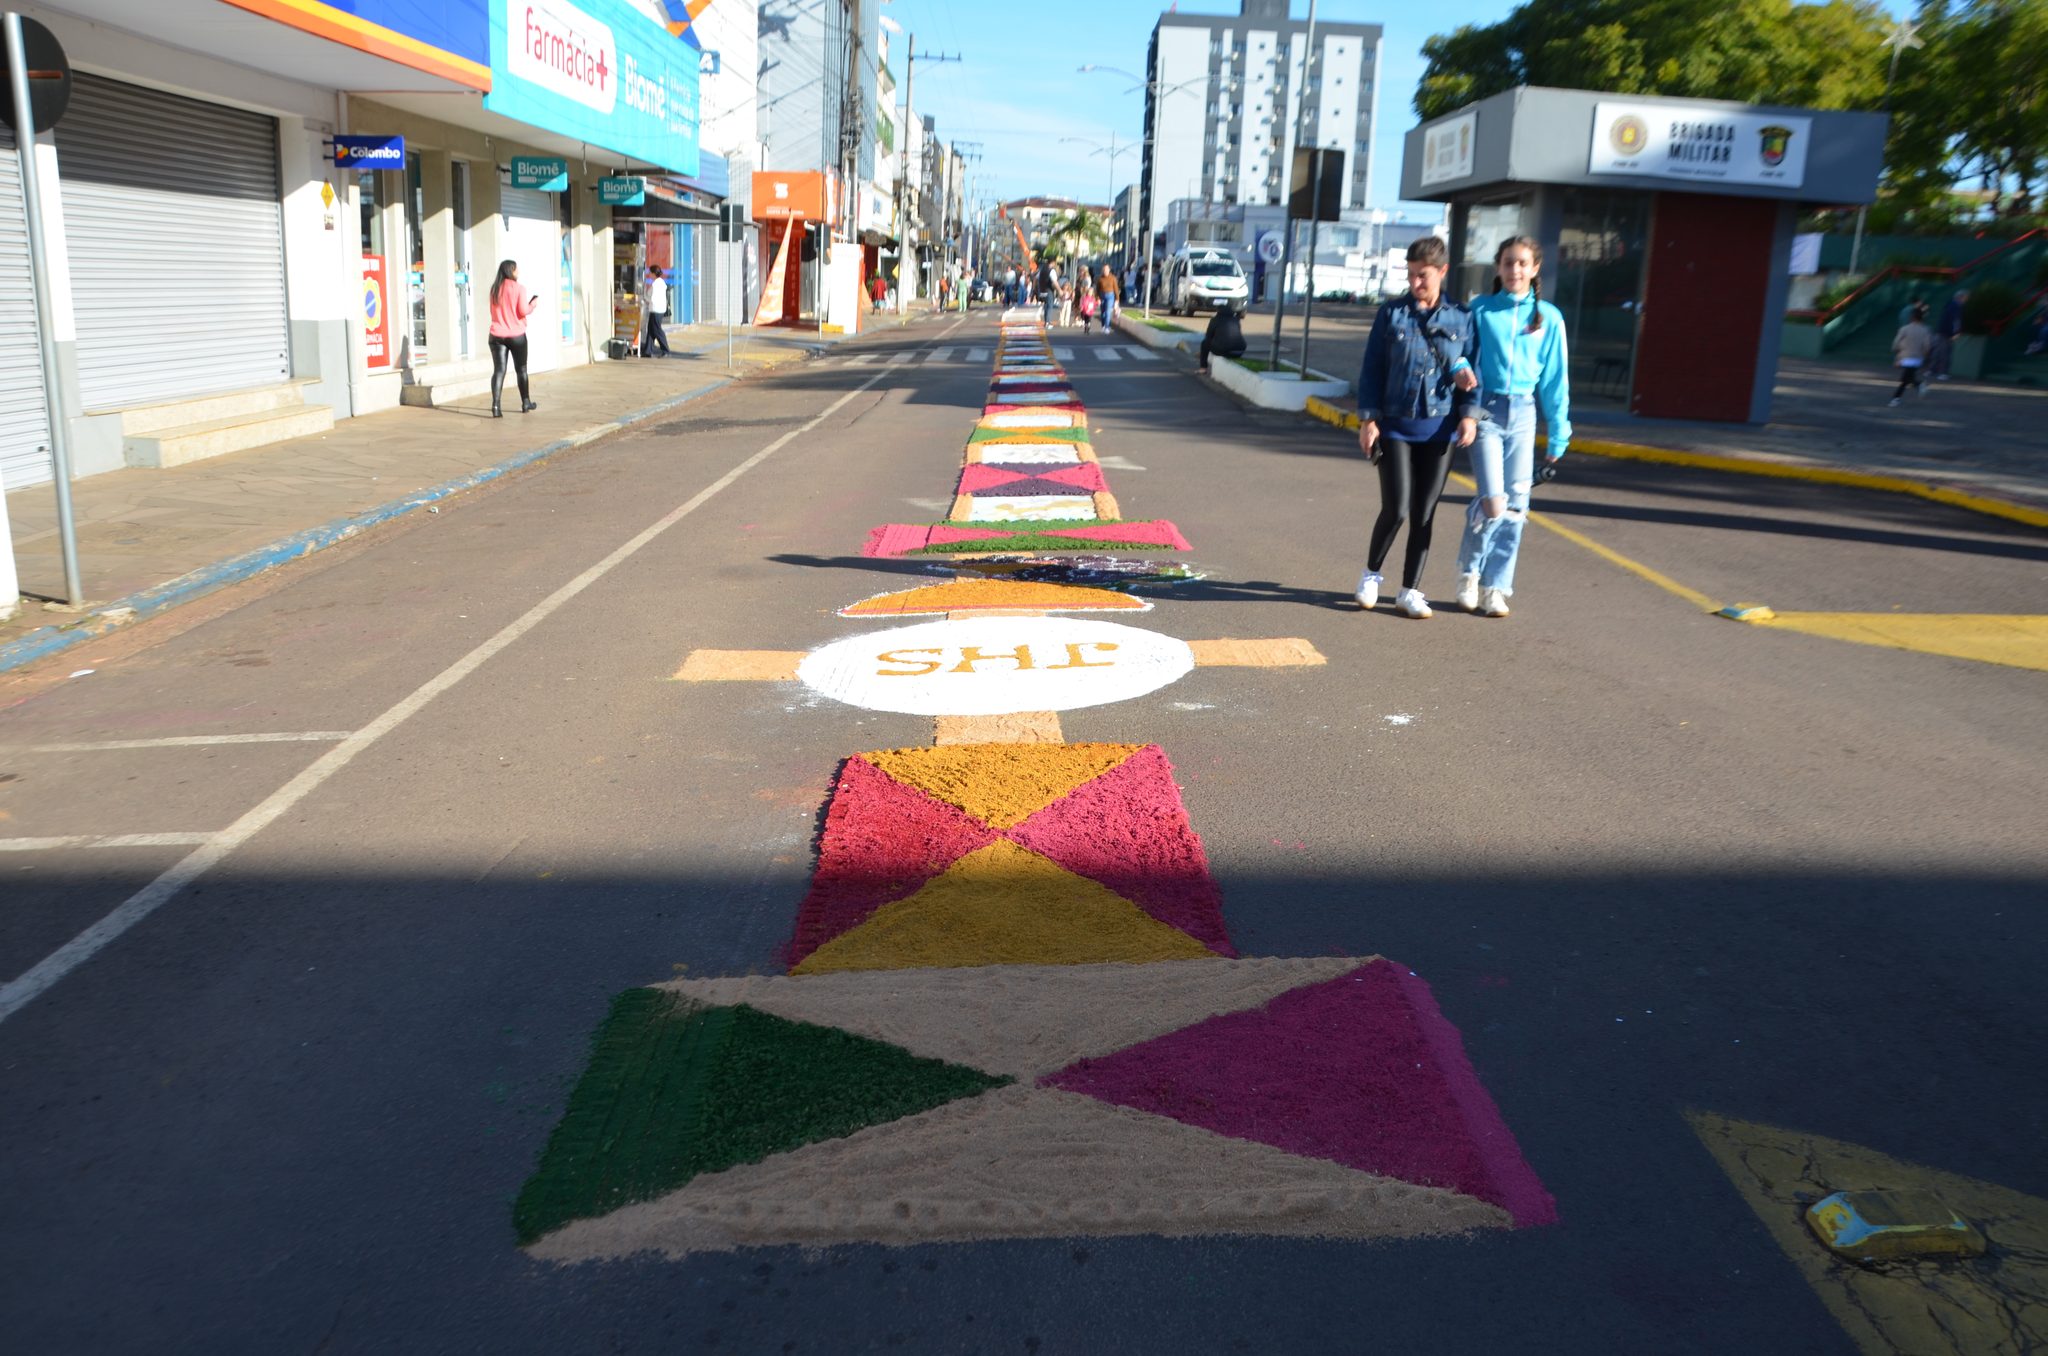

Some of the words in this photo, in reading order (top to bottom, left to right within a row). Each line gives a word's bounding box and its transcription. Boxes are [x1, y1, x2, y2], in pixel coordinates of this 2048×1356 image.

[1669, 121, 1736, 142] BRIGADA
[350, 146, 401, 159] Colombo
[1667, 143, 1731, 164] MILITAR
